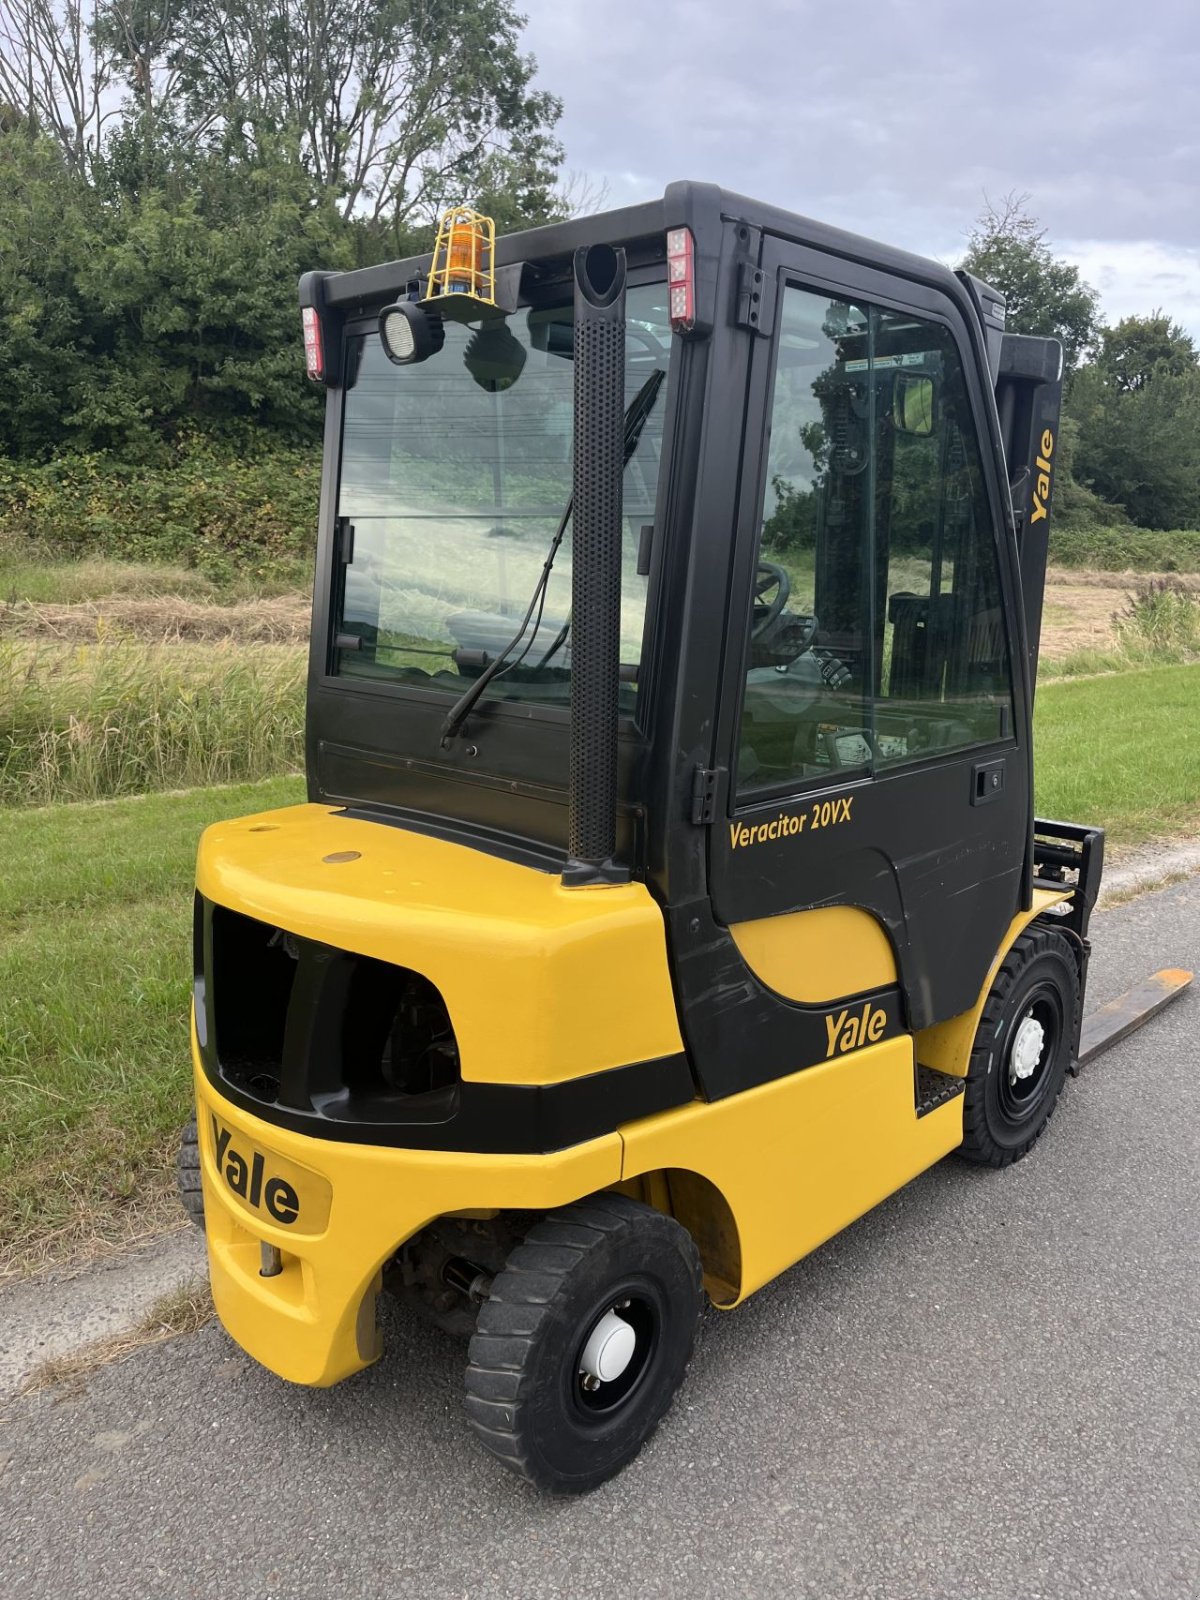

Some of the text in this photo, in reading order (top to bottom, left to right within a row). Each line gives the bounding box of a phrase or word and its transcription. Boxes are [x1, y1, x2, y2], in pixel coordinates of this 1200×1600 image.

[1031, 428, 1054, 525] Yale
[729, 796, 854, 850] Veracitor 20VX
[825, 1002, 887, 1058] Yale
[211, 1112, 300, 1225] Yale
